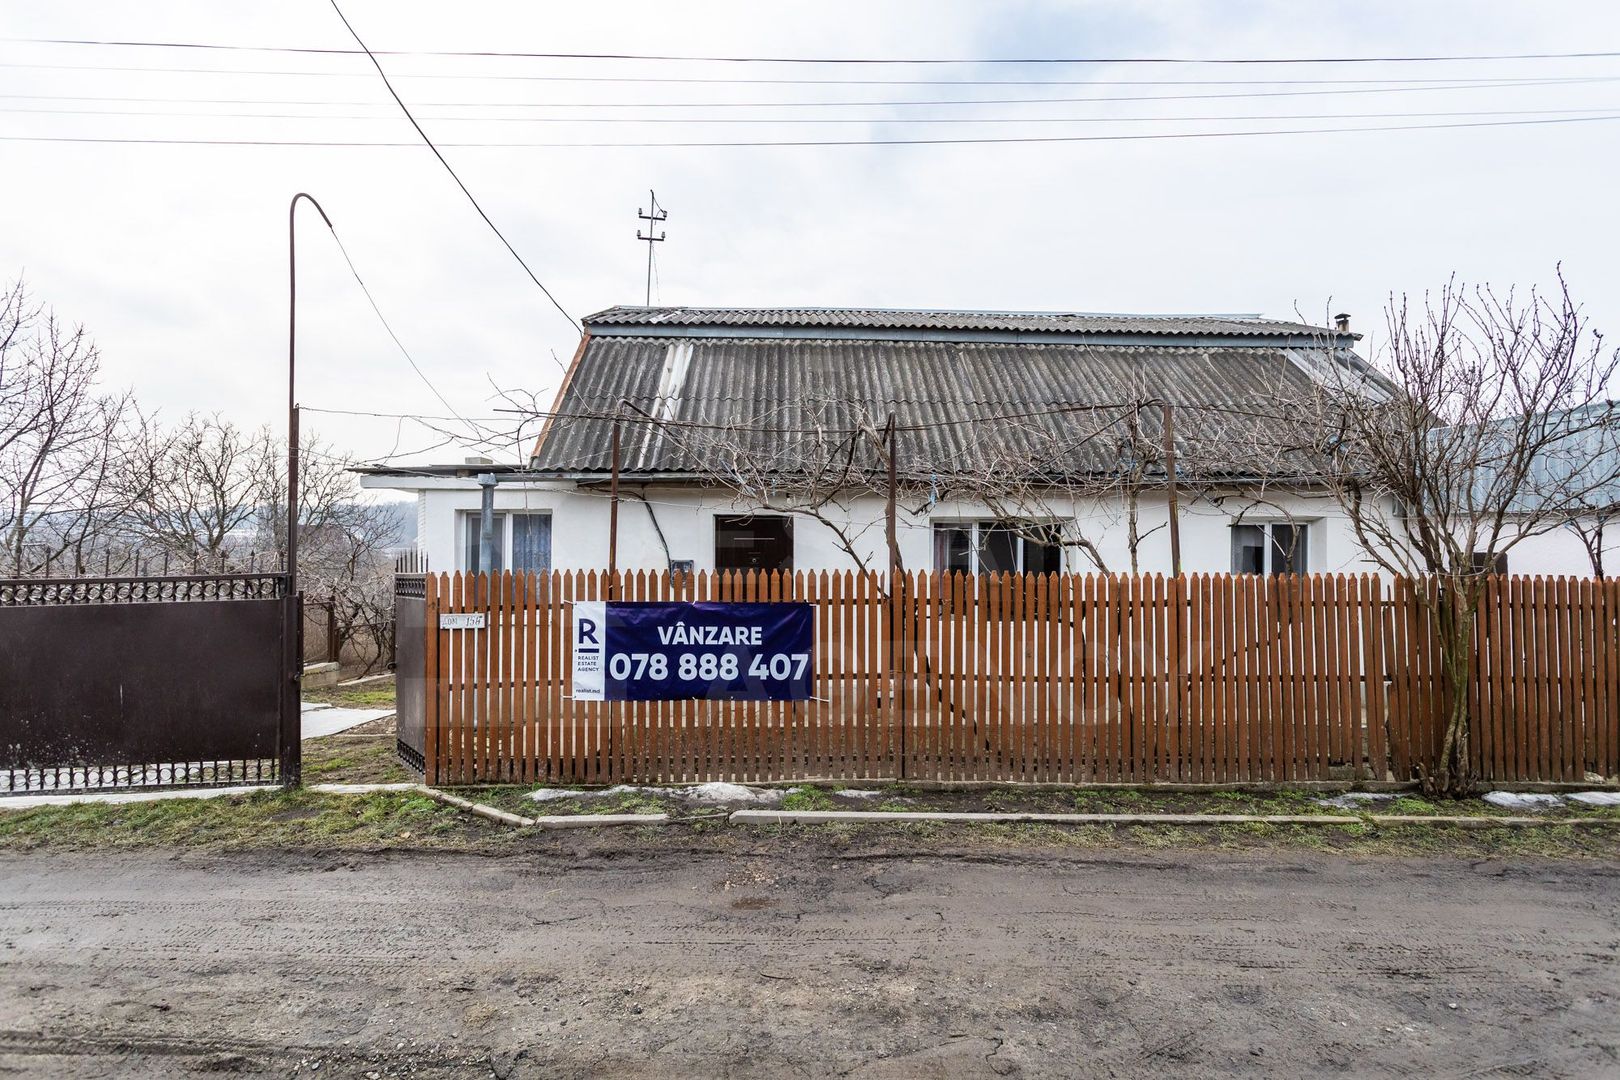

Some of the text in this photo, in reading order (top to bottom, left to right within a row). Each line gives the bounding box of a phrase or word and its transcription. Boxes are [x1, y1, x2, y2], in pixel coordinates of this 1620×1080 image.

[579, 618, 599, 644] R
[657, 621, 762, 645] VÂNZARE
[609, 653, 809, 681] 078 888 407
